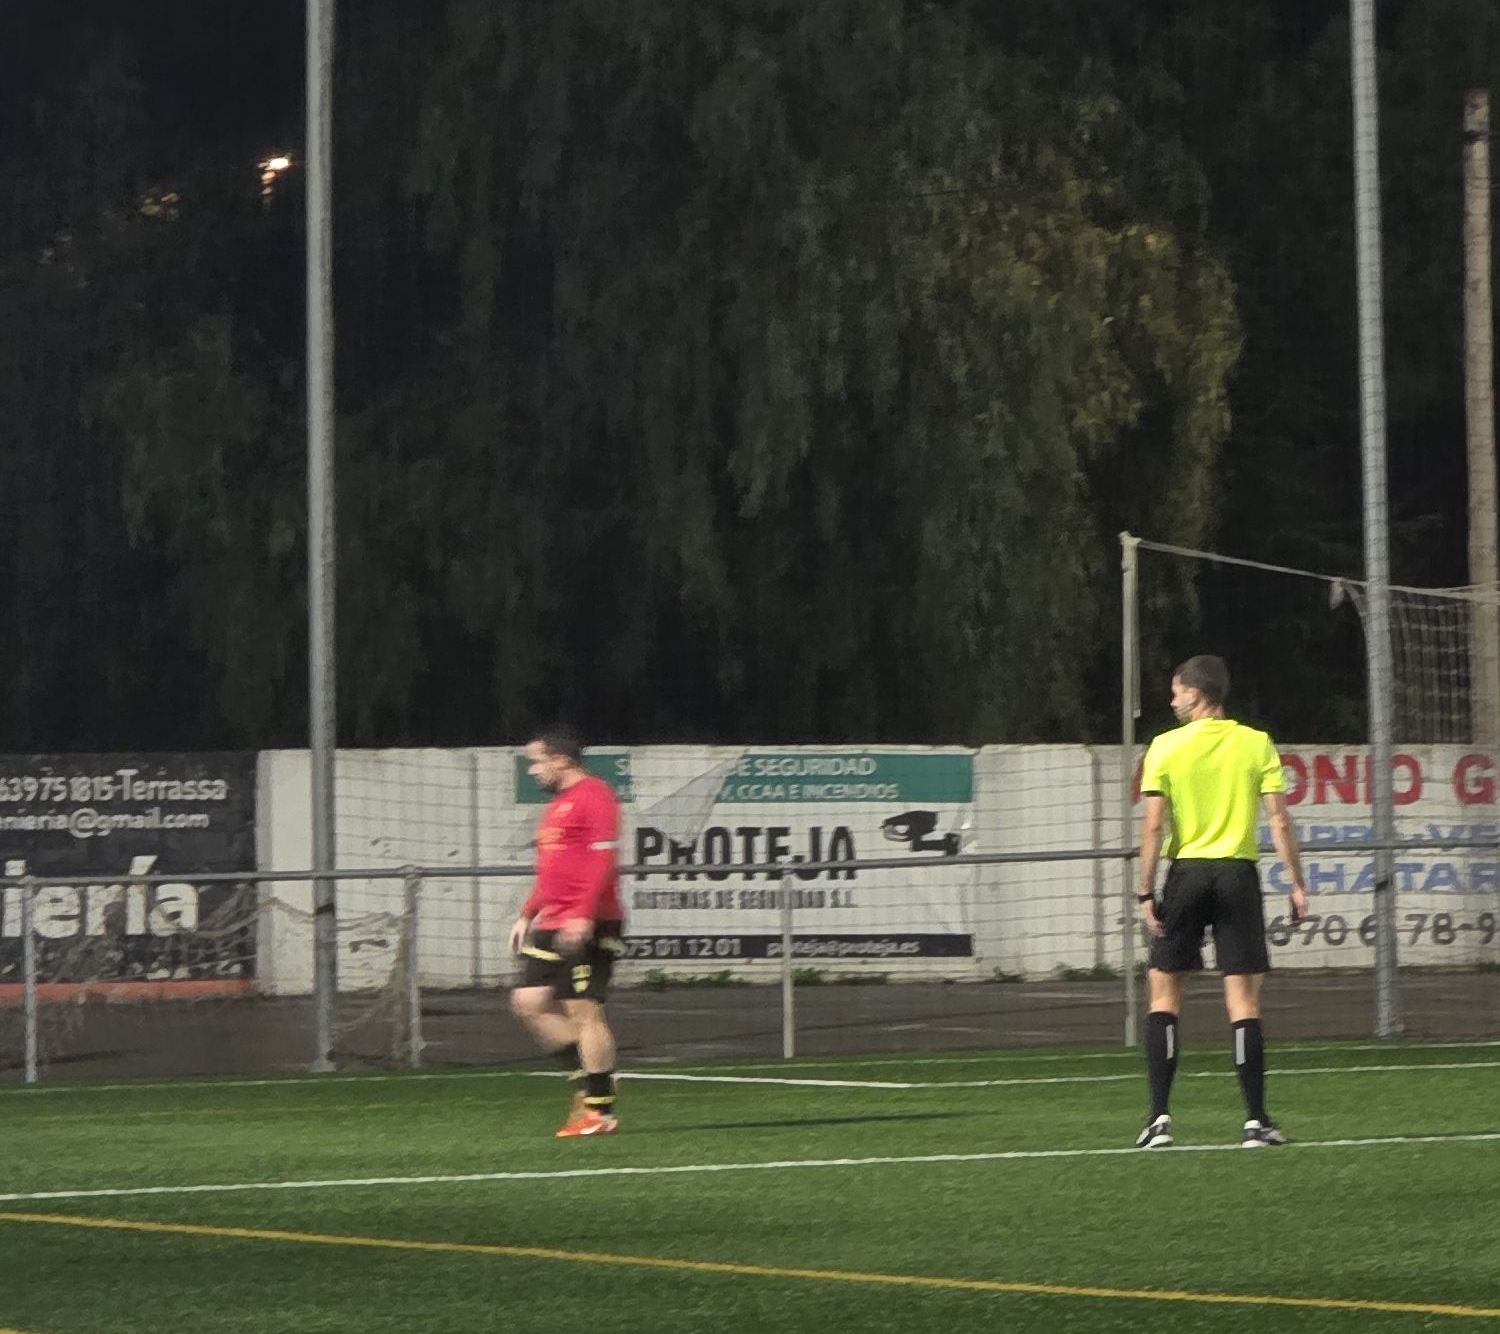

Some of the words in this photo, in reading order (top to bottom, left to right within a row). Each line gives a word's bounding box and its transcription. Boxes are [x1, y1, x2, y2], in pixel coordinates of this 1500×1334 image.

[754, 757, 877, 777] SEGURIDAD
[634, 826, 857, 882] PROTEJA
[738, 889, 826, 909] SEGUIDAD
[765, 938, 921, 958] prteja@proteja.es
